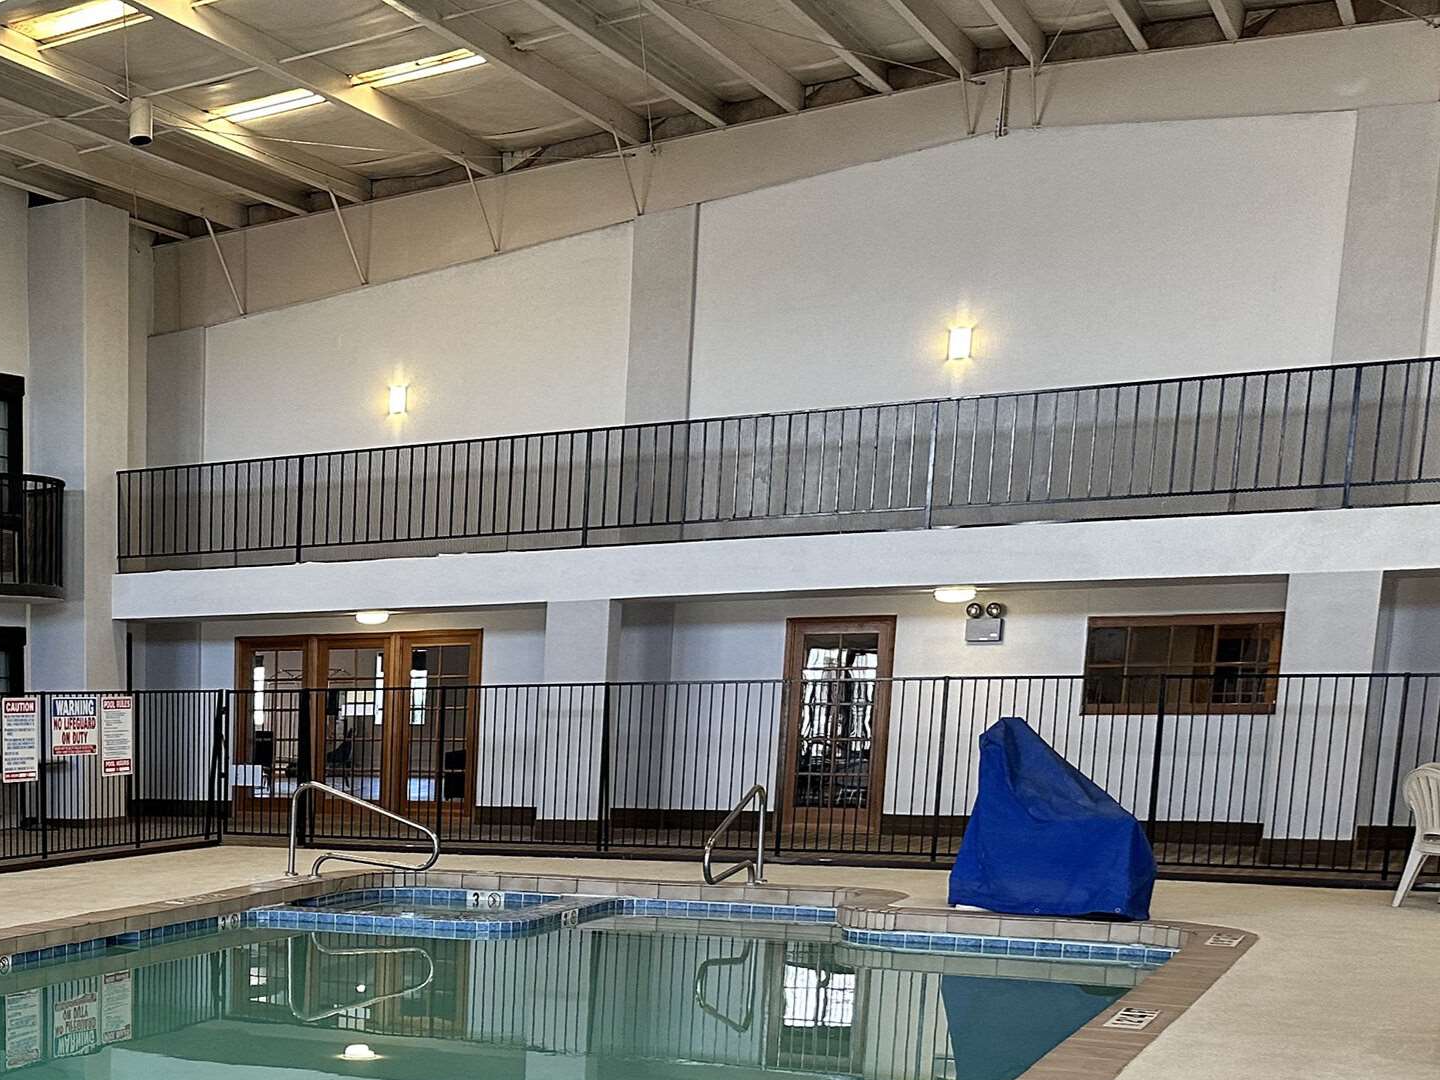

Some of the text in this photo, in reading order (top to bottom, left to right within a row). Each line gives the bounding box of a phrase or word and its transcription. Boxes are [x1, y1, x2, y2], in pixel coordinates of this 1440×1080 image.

[5, 702, 34, 712] CAUTION
[56, 699, 94, 716] WARNING
[53, 717, 96, 730] NO LIFEGUARD
[62, 731, 88, 744] ON DUTY
